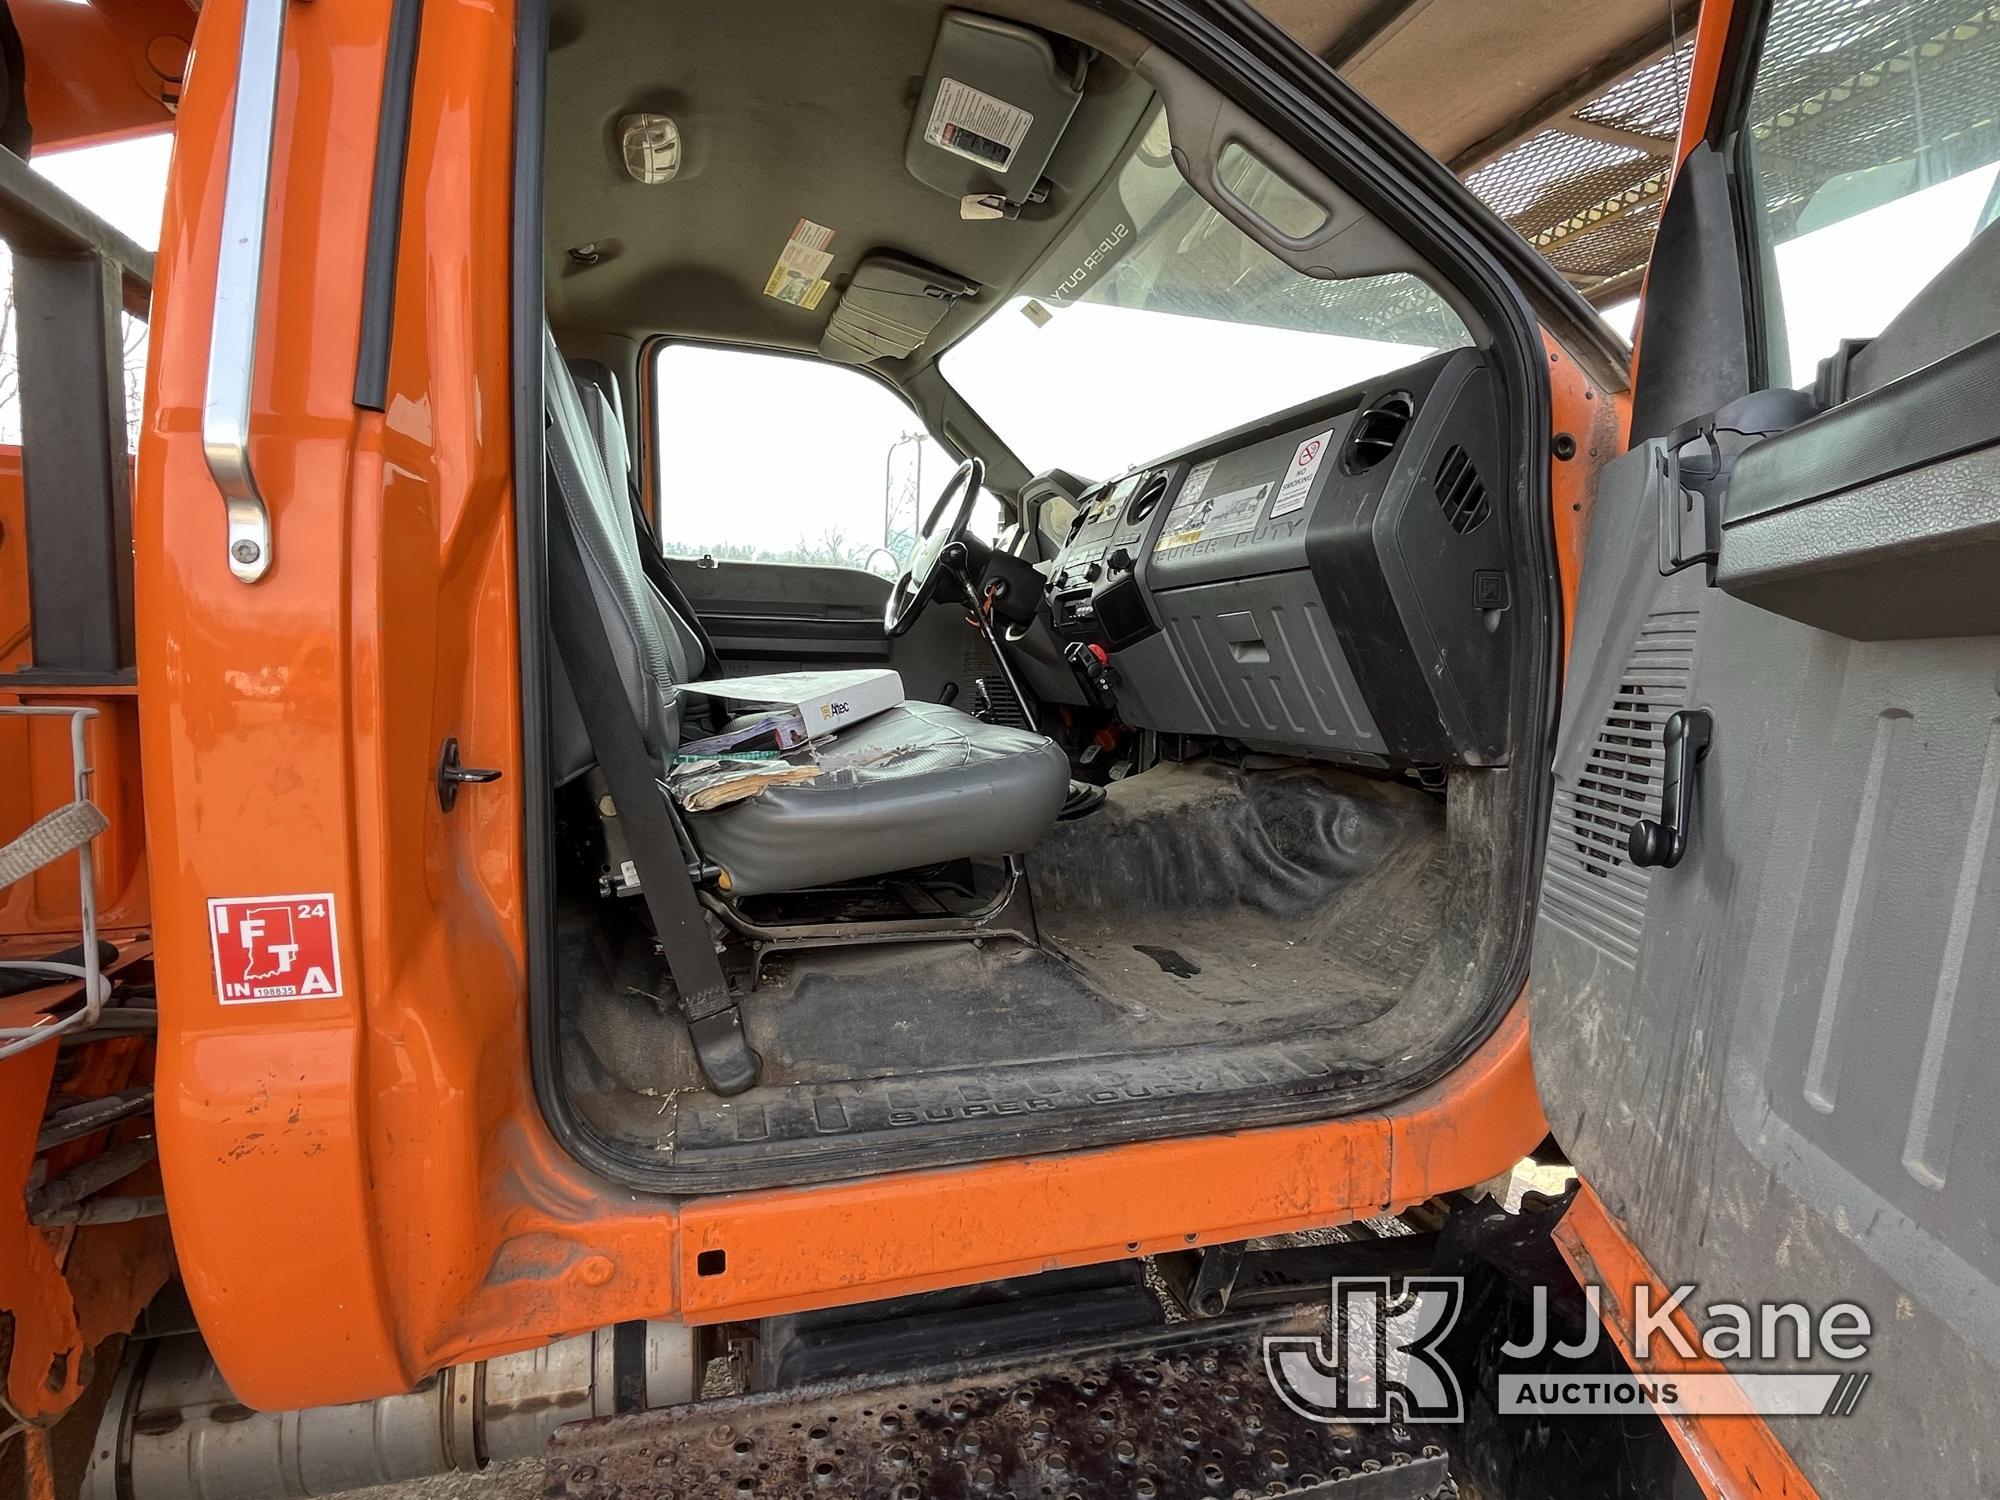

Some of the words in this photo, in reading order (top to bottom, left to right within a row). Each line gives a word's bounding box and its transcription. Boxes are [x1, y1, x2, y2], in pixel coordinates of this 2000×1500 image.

[297, 904, 325, 918] 24
[226, 982, 251, 997] IN
[888, 1098, 1055, 1127] SUPER
